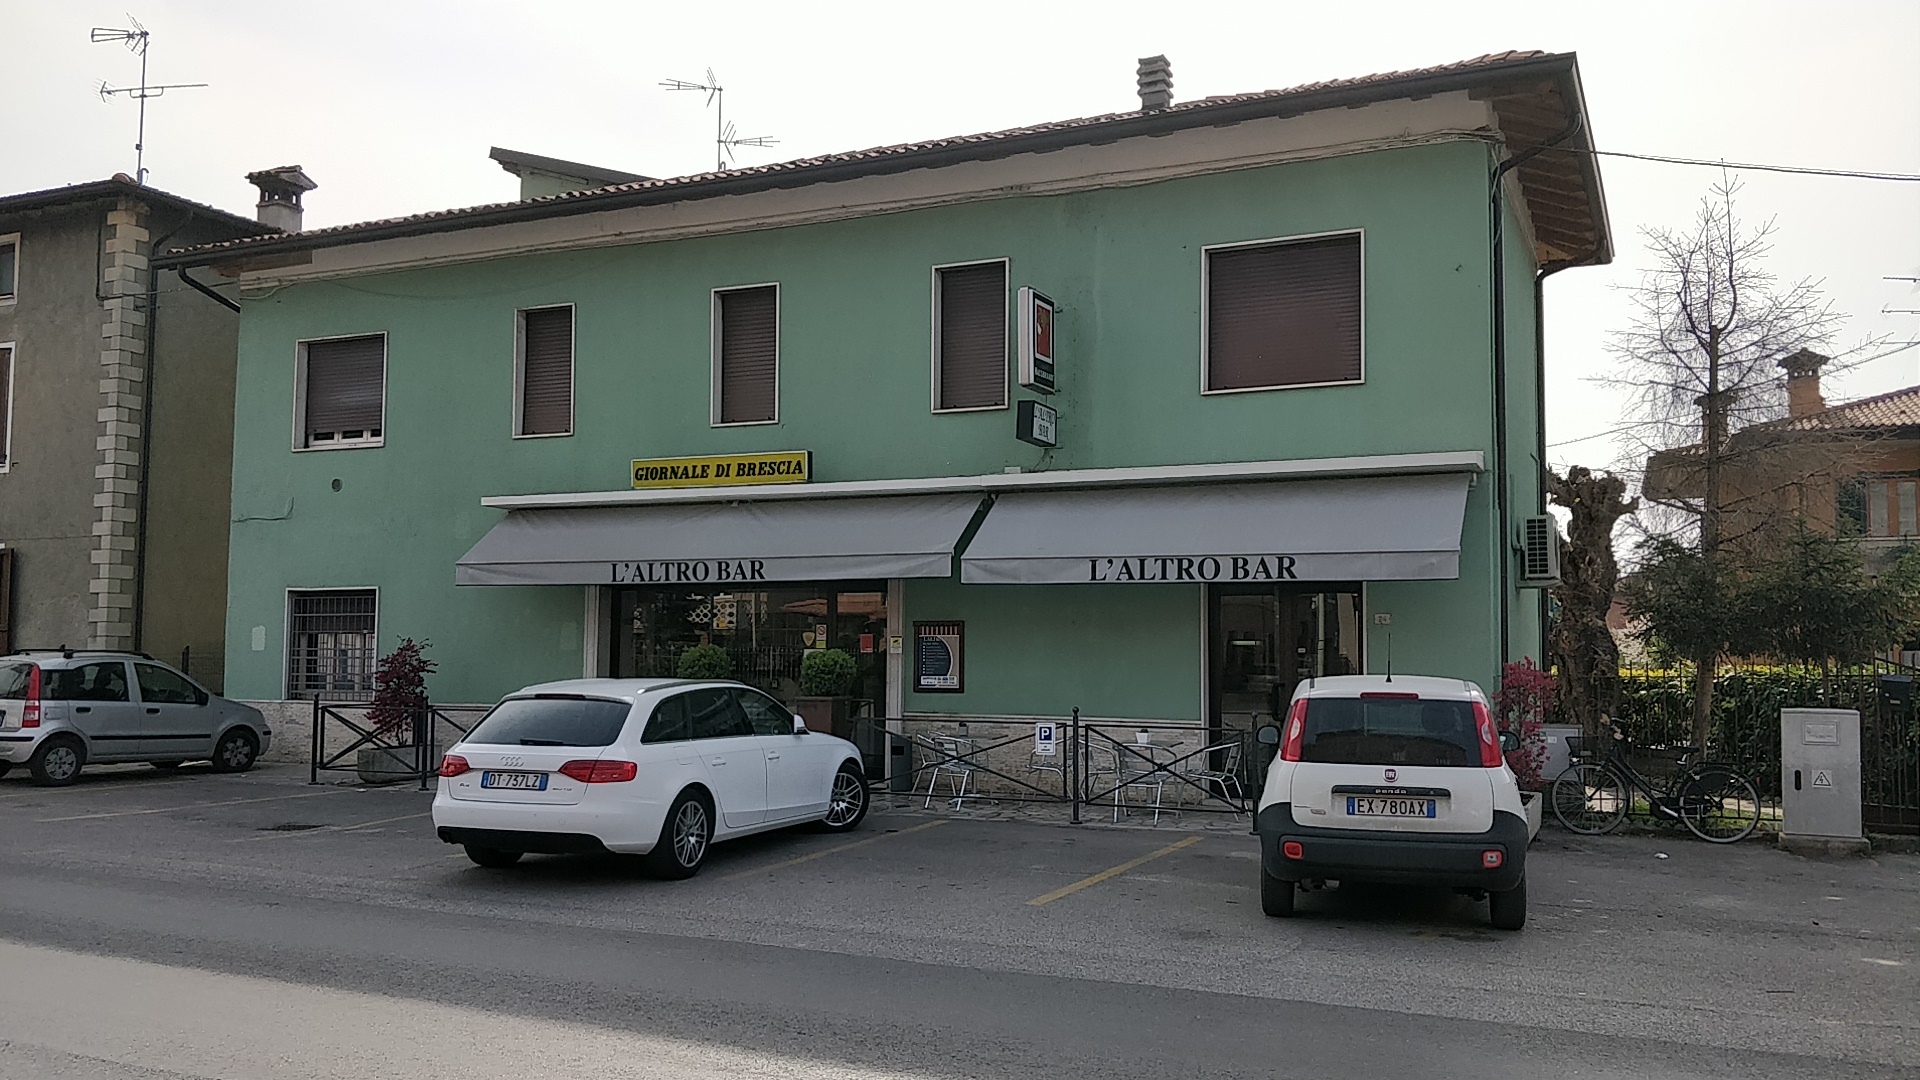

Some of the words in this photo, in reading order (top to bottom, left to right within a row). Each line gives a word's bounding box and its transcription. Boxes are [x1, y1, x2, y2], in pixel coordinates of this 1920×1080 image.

[634, 464, 710, 481] GIORNALE
[714, 463, 732, 478] DI
[736, 460, 804, 477] BRESCIA
[611, 561, 710, 583] L'ALTRO
[716, 560, 766, 581] BAR
[1089, 556, 1221, 581] L'ALTRO
[1230, 556, 1298, 580] BAR
[1041, 727, 1050, 740] P
